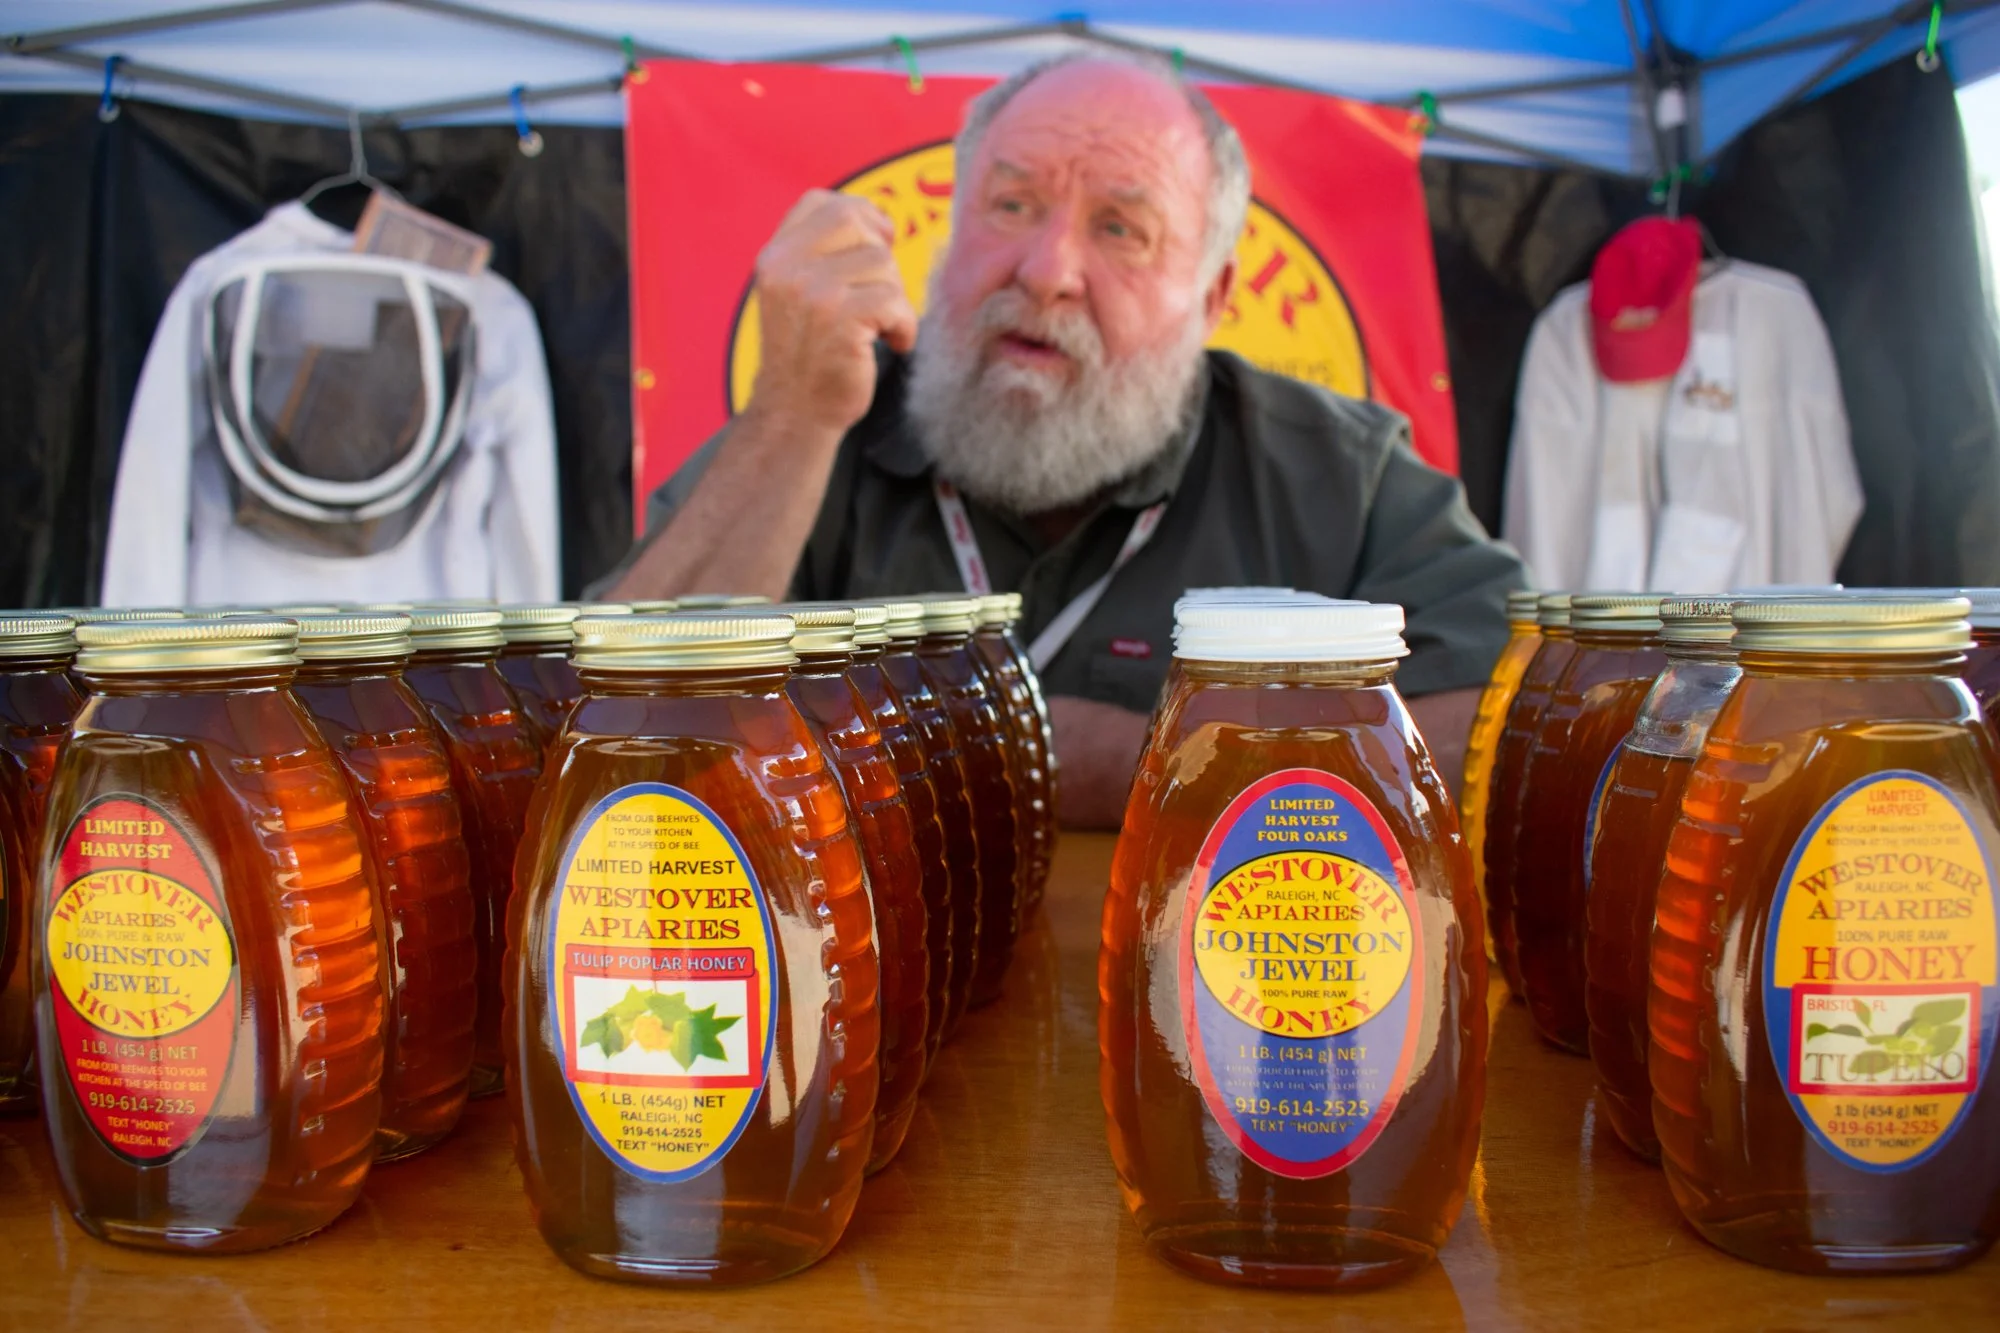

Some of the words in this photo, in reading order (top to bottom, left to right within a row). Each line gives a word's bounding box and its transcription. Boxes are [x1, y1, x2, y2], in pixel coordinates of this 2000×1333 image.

[1869, 789, 1926, 802] LIMITED
[1269, 799, 1335, 811] LIMITED
[1866, 803, 1928, 816] HARVEST
[85, 819, 165, 836] LIMITED
[606, 814, 631, 824] FROM
[634, 814, 654, 824] OUR
[656, 814, 700, 824] BEEHIVES
[1265, 815, 1340, 827] HARVEST
[613, 827, 625, 836] TO
[627, 827, 651, 837] YOUR
[654, 828, 693, 837] KITCHEN
[1257, 831, 1300, 842] FOUR
[1304, 831, 1348, 842] OAKS
[80, 841, 172, 859] HARVEST
[607, 840, 618, 849] AT
[620, 840, 636, 850] THE
[638, 841, 666, 850] SPEED
[668, 841, 681, 850] OF
[683, 841, 700, 850] BEE
[576, 858, 643, 875] LIMITED
[649, 859, 736, 875] HARVEST
[1797, 852, 1982, 897] WESTOVER
[1202, 857, 1398, 925] WESTOVER
[1266, 890, 1320, 902] RALEIGH,
[1323, 890, 1341, 901] NC
[1855, 881, 1912, 894] RALEIGH,
[1915, 881, 1934, 893] NC
[55, 873, 213, 933] WESTOVER
[565, 884, 753, 910] WESTOVER
[1237, 904, 1366, 922] APIARIES
[1807, 898, 1973, 921] APIARIES
[81, 910, 176, 927] APIARIES
[107, 930, 138, 942] PURE
[157, 932, 185, 943] RAW
[580, 916, 741, 940] APIARIES
[1837, 930, 1873, 943] 100%
[1878, 930, 1913, 942] PURE
[1918, 930, 1948, 941] RAW
[1198, 929, 1406, 955] JOHNSTON
[63, 941, 212, 967] JOHNSTON
[573, 951, 615, 969] TULIP
[618, 954, 682, 971] POPLAR
[687, 956, 747, 971] HONEY
[1801, 944, 1975, 981] HONEY
[1239, 958, 1366, 982] JEWEL
[89, 972, 181, 995] JEWEL
[1262, 989, 1289, 999] 100%
[1291, 989, 1320, 999] PURE
[1323, 989, 1348, 999] RAW
[77, 986, 196, 1030] HONEY
[1226, 984, 1373, 1033] HONEY
[1872, 999, 1887, 1012] FL
[82, 1039, 88, 1053] 1
[92, 1041, 111, 1055] LB.
[115, 1042, 145, 1058] (454
[168, 1046, 198, 1060] NET
[1239, 1044, 1245, 1059] 1
[1252, 1045, 1274, 1060] LB.
[1279, 1046, 1313, 1062] (454
[1318, 1048, 1333, 1064] g)
[1337, 1047, 1367, 1061] NET
[76, 1058, 101, 1070] FROM
[101, 1061, 119, 1072] OUR
[165, 1066, 178, 1076] TO
[179, 1067, 208, 1078] YOUR
[1805, 1051, 1964, 1082] TUPELO
[112, 1076, 123, 1087] AT
[125, 1078, 141, 1089] THE
[143, 1079, 171, 1091] SPEED
[173, 1081, 187, 1092] OF
[188, 1081, 207, 1092] BEE
[89, 1091, 196, 1114] 919-614-2525
[600, 1091, 606, 1104] 1
[612, 1092, 637, 1106] LB.
[641, 1094, 688, 1111] (454g)
[694, 1095, 726, 1108] NET
[1235, 1096, 1370, 1117] 919-614-2525
[620, 1111, 681, 1125] RALEIGH,
[685, 1113, 703, 1124] NC
[1835, 1105, 1841, 1117] 1
[1846, 1104, 1858, 1117] lb
[1863, 1105, 1893, 1118] (454
[1913, 1103, 1939, 1116] NET
[107, 1116, 129, 1128] TEXT
[1251, 1119, 1284, 1132] TEXT
[1828, 1119, 1940, 1135] 919-614-2525
[622, 1126, 702, 1138] 919-614-2525
[158, 1137, 172, 1147] NC
[617, 1139, 646, 1151] TEXT
[1845, 1137, 1870, 1148] TEXT
